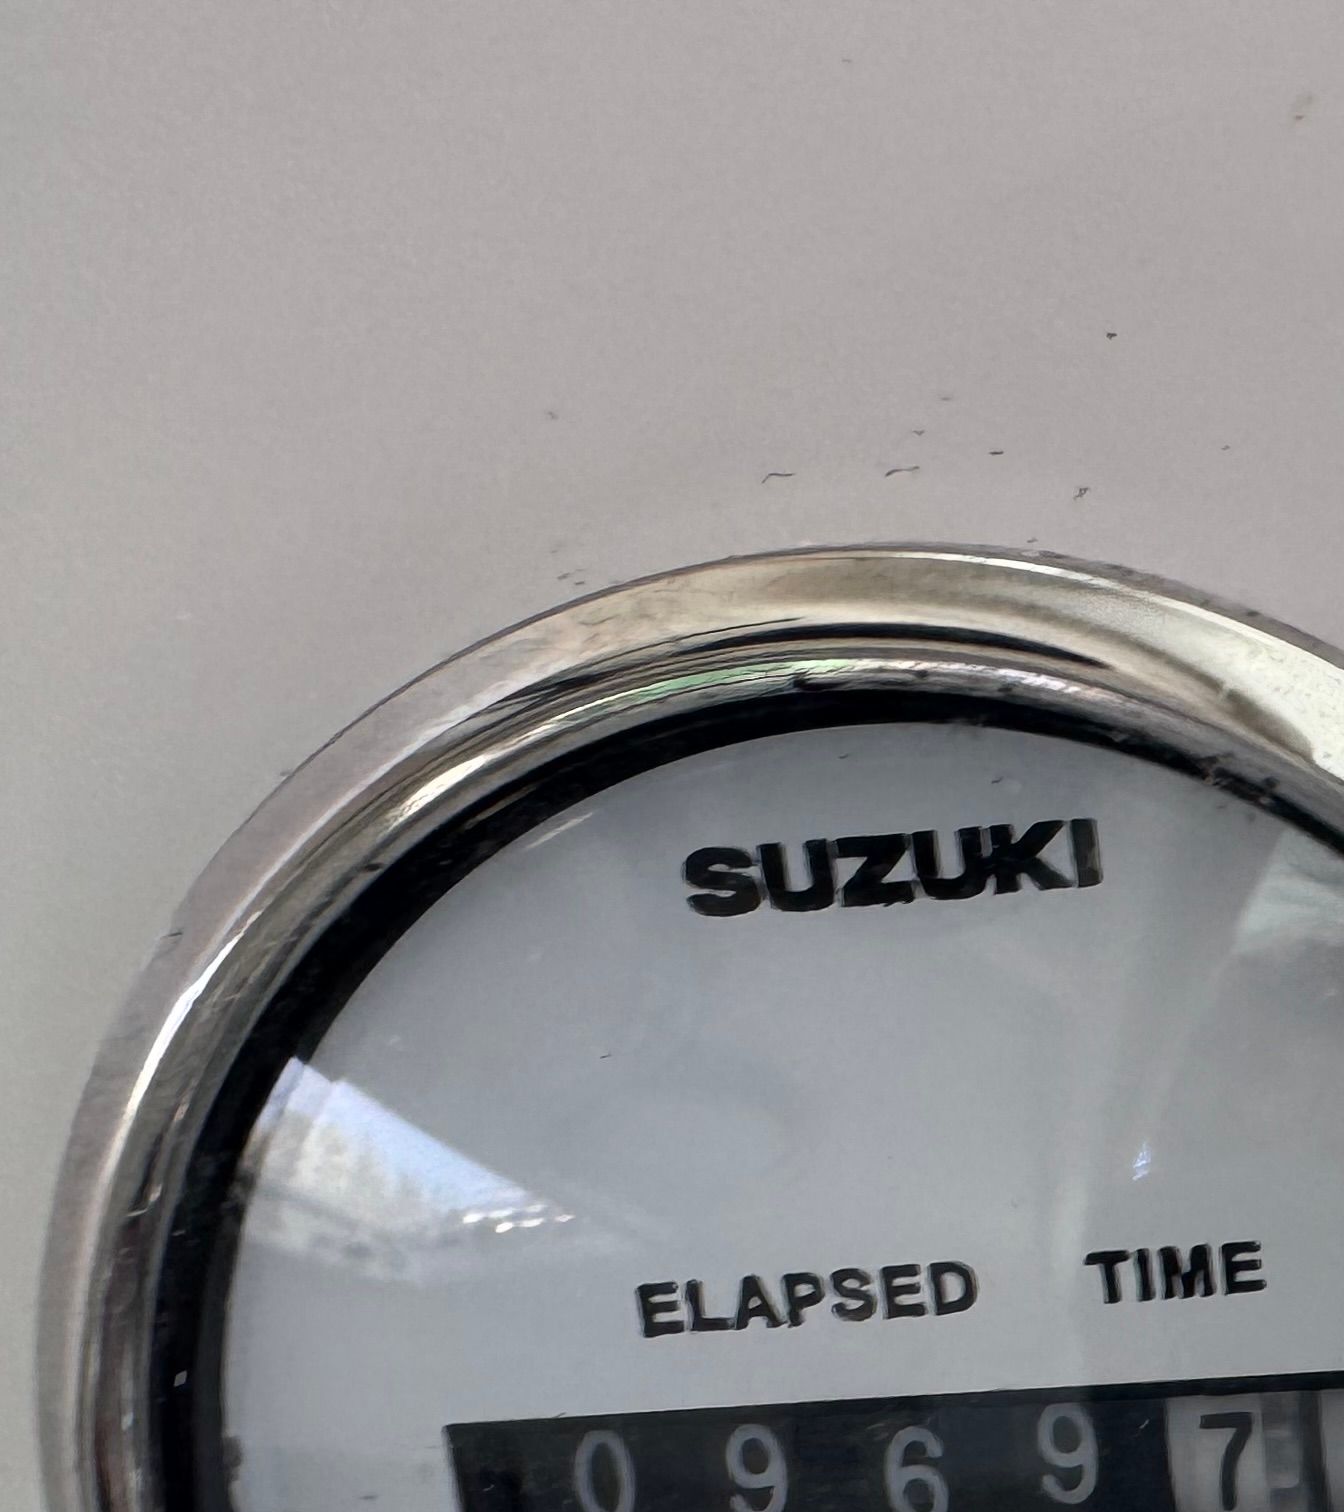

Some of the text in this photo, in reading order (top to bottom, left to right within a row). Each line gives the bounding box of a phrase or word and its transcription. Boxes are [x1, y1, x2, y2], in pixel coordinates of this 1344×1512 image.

[682, 818, 1103, 917] SUZUKI
[635, 1240, 1268, 1338] ELAPSED TIME
